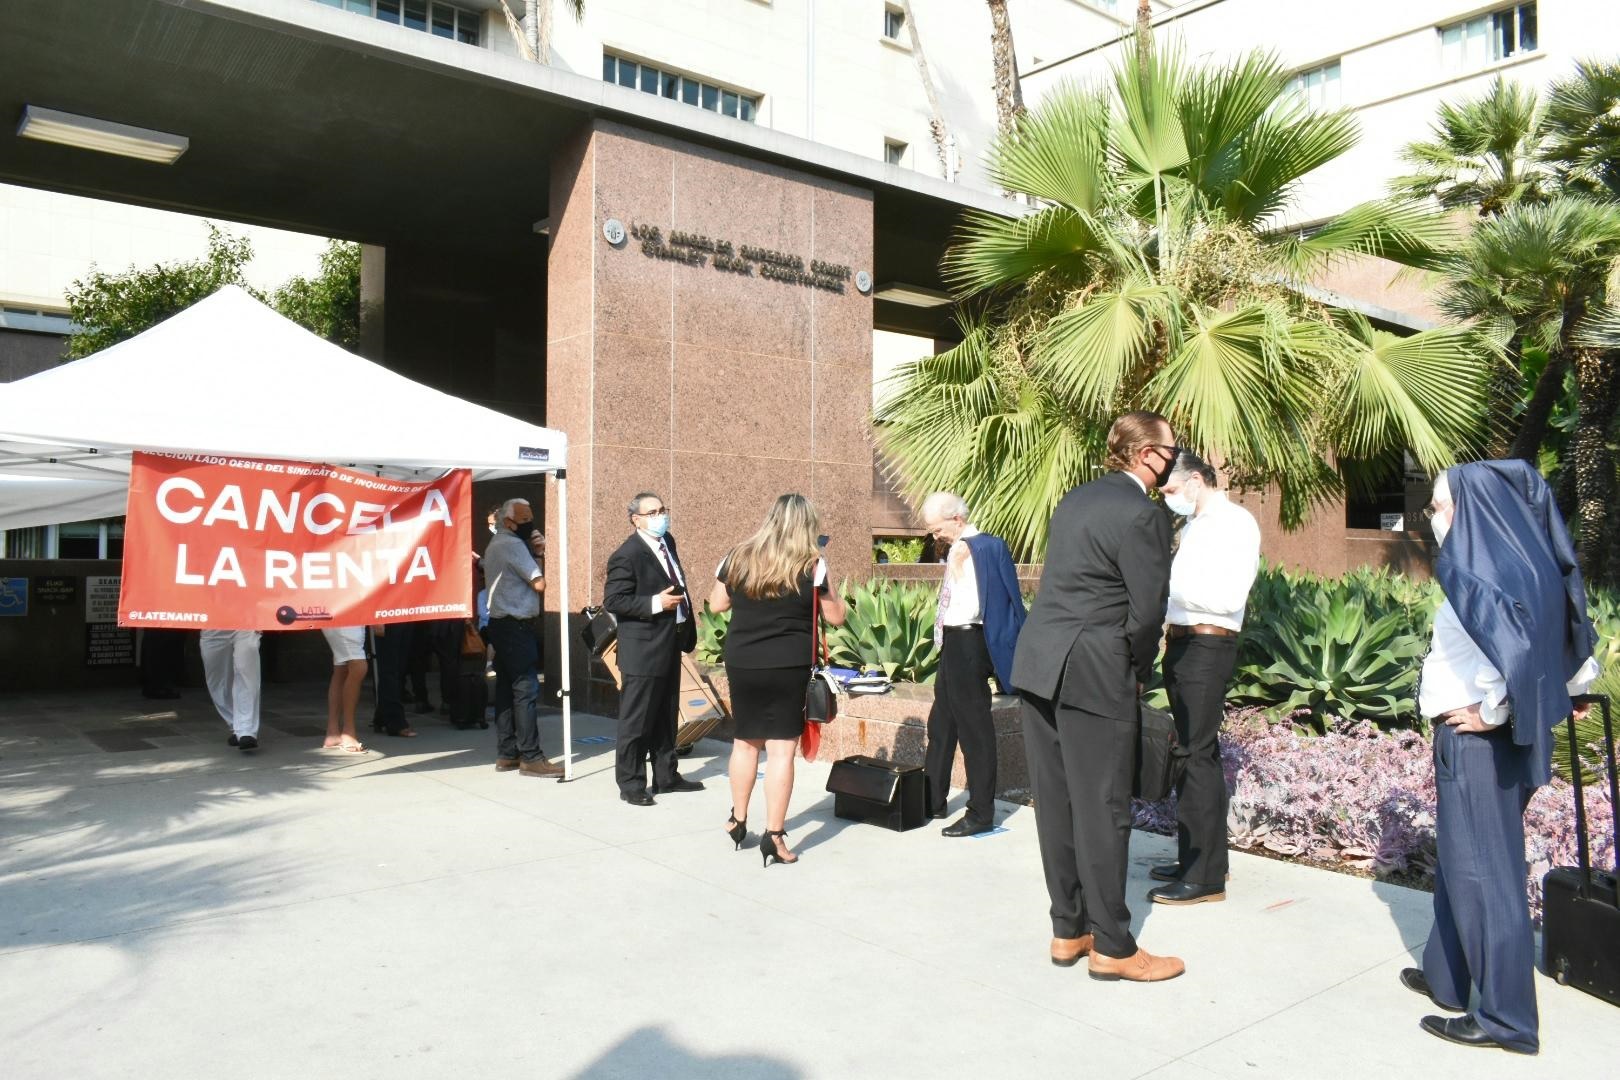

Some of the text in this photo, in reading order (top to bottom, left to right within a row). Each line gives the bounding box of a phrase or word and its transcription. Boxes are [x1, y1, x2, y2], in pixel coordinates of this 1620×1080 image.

[630, 221, 851, 279] LOS ANGELES SUPERIOR COURT
[195, 455, 227, 466] LADO
[229, 458, 263, 471] OESTE
[265, 463, 285, 474] DEL
[287, 465, 338, 479] SINDICATO
[339, 473, 354, 483] DE
[354, 477, 410, 493] INQUILINXS
[155, 477, 453, 535] CANCELA
[175, 544, 437, 589] LA RENTA
[128, 611, 208, 622] @LATENANTS
[375, 603, 467, 619] FOODNOTRENT.ORG
